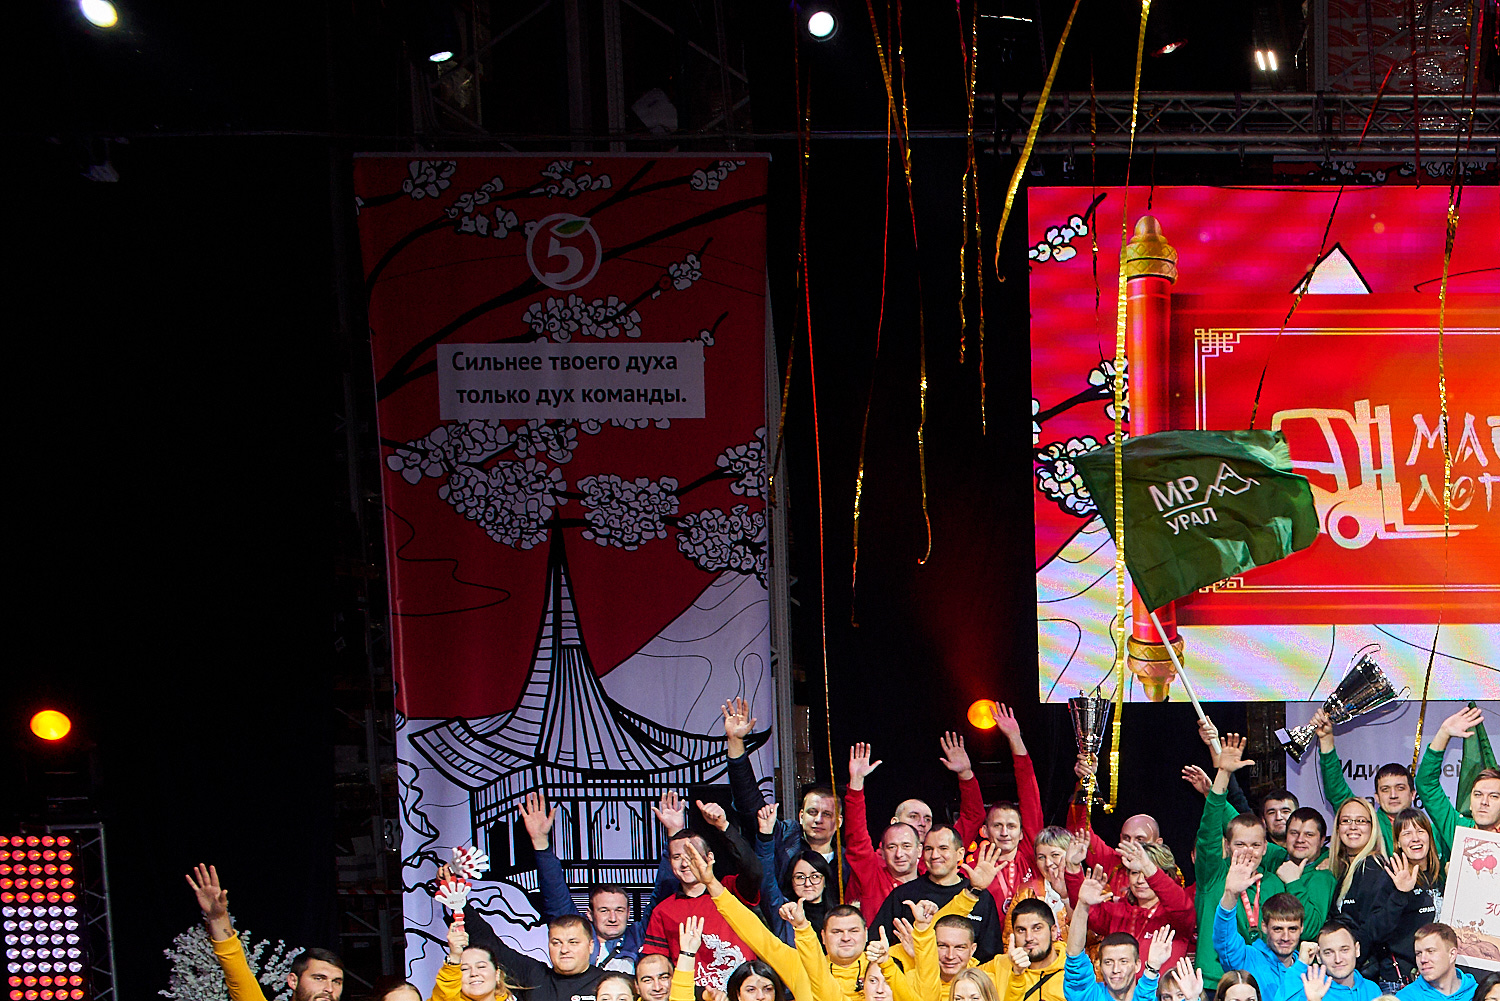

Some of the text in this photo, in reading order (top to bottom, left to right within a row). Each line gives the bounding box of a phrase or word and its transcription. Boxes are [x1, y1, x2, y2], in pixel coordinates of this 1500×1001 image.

[452, 351, 678, 375] Сильнее твоего духа
[456, 387, 687, 408] только дух команды.
[1148, 476, 1200, 512] МР
[1166, 507, 1218, 535] УРАЛ
